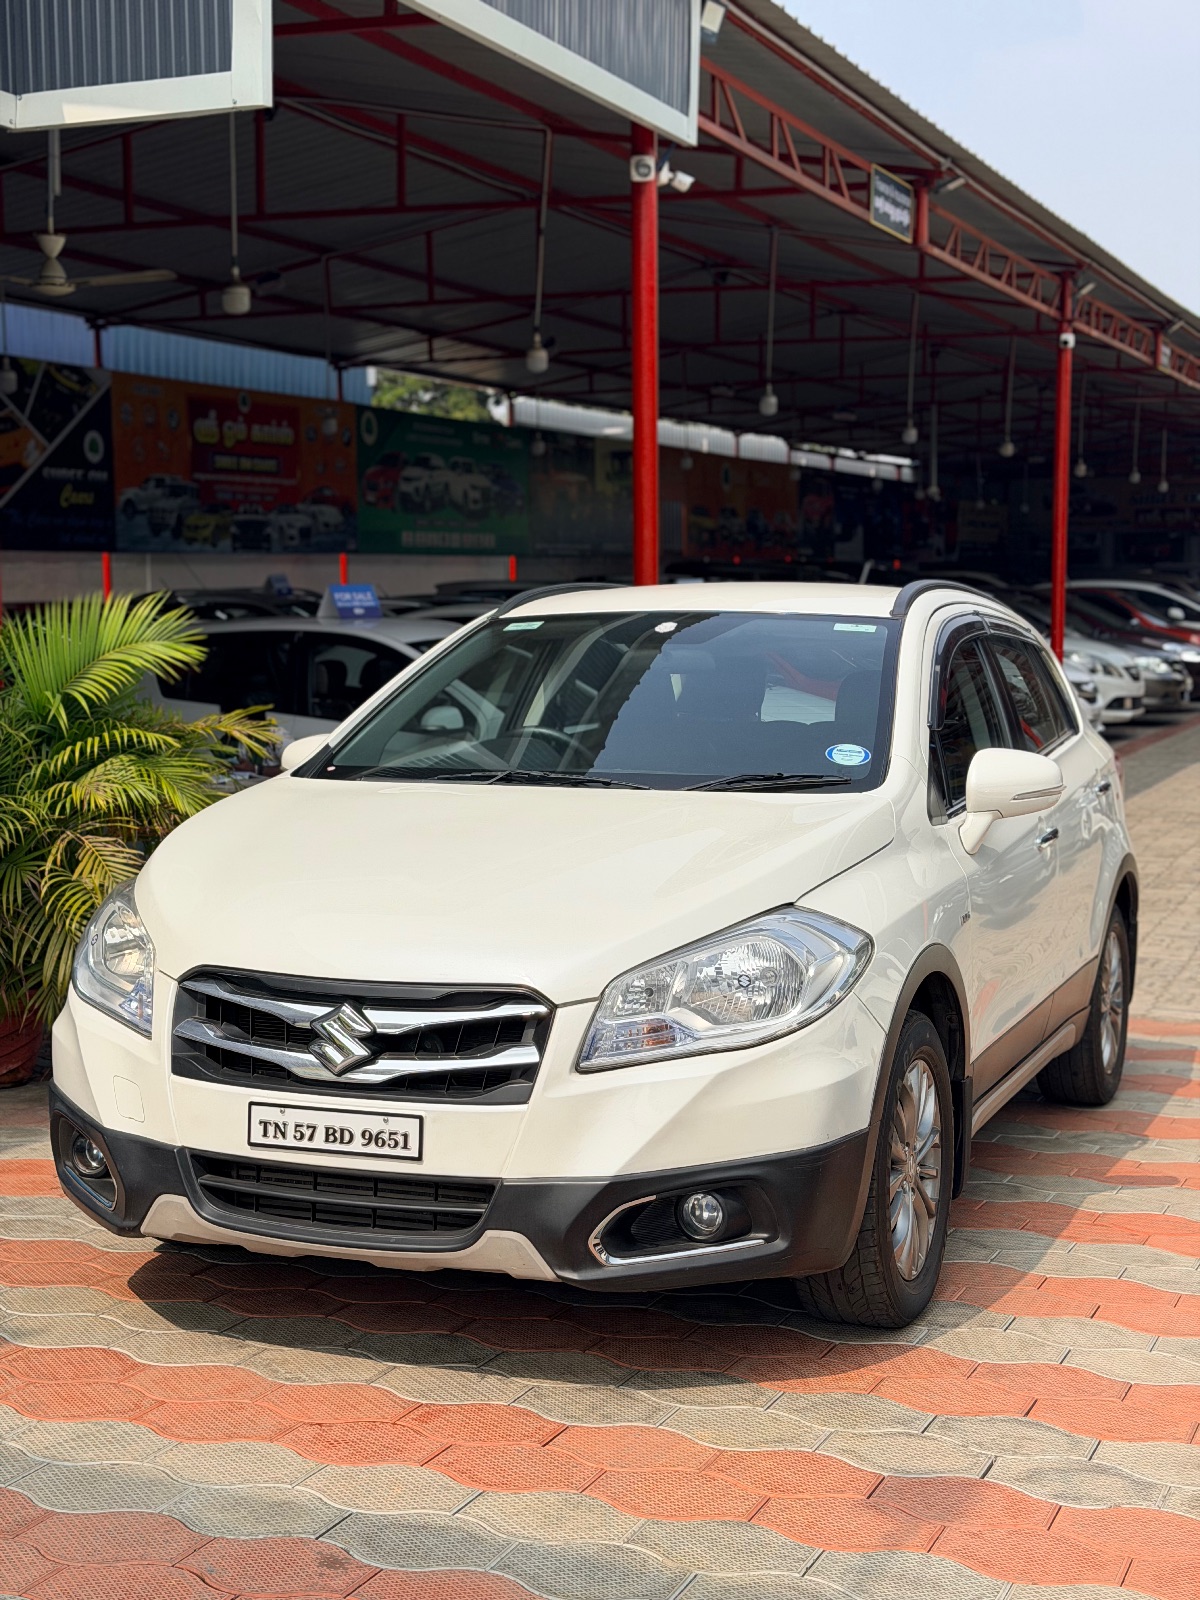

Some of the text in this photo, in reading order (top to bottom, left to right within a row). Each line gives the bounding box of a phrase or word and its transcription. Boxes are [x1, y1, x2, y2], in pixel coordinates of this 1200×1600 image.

[333, 591, 373, 600] FOR SALE
[258, 1119, 412, 1151] TN 57 BD 9651
